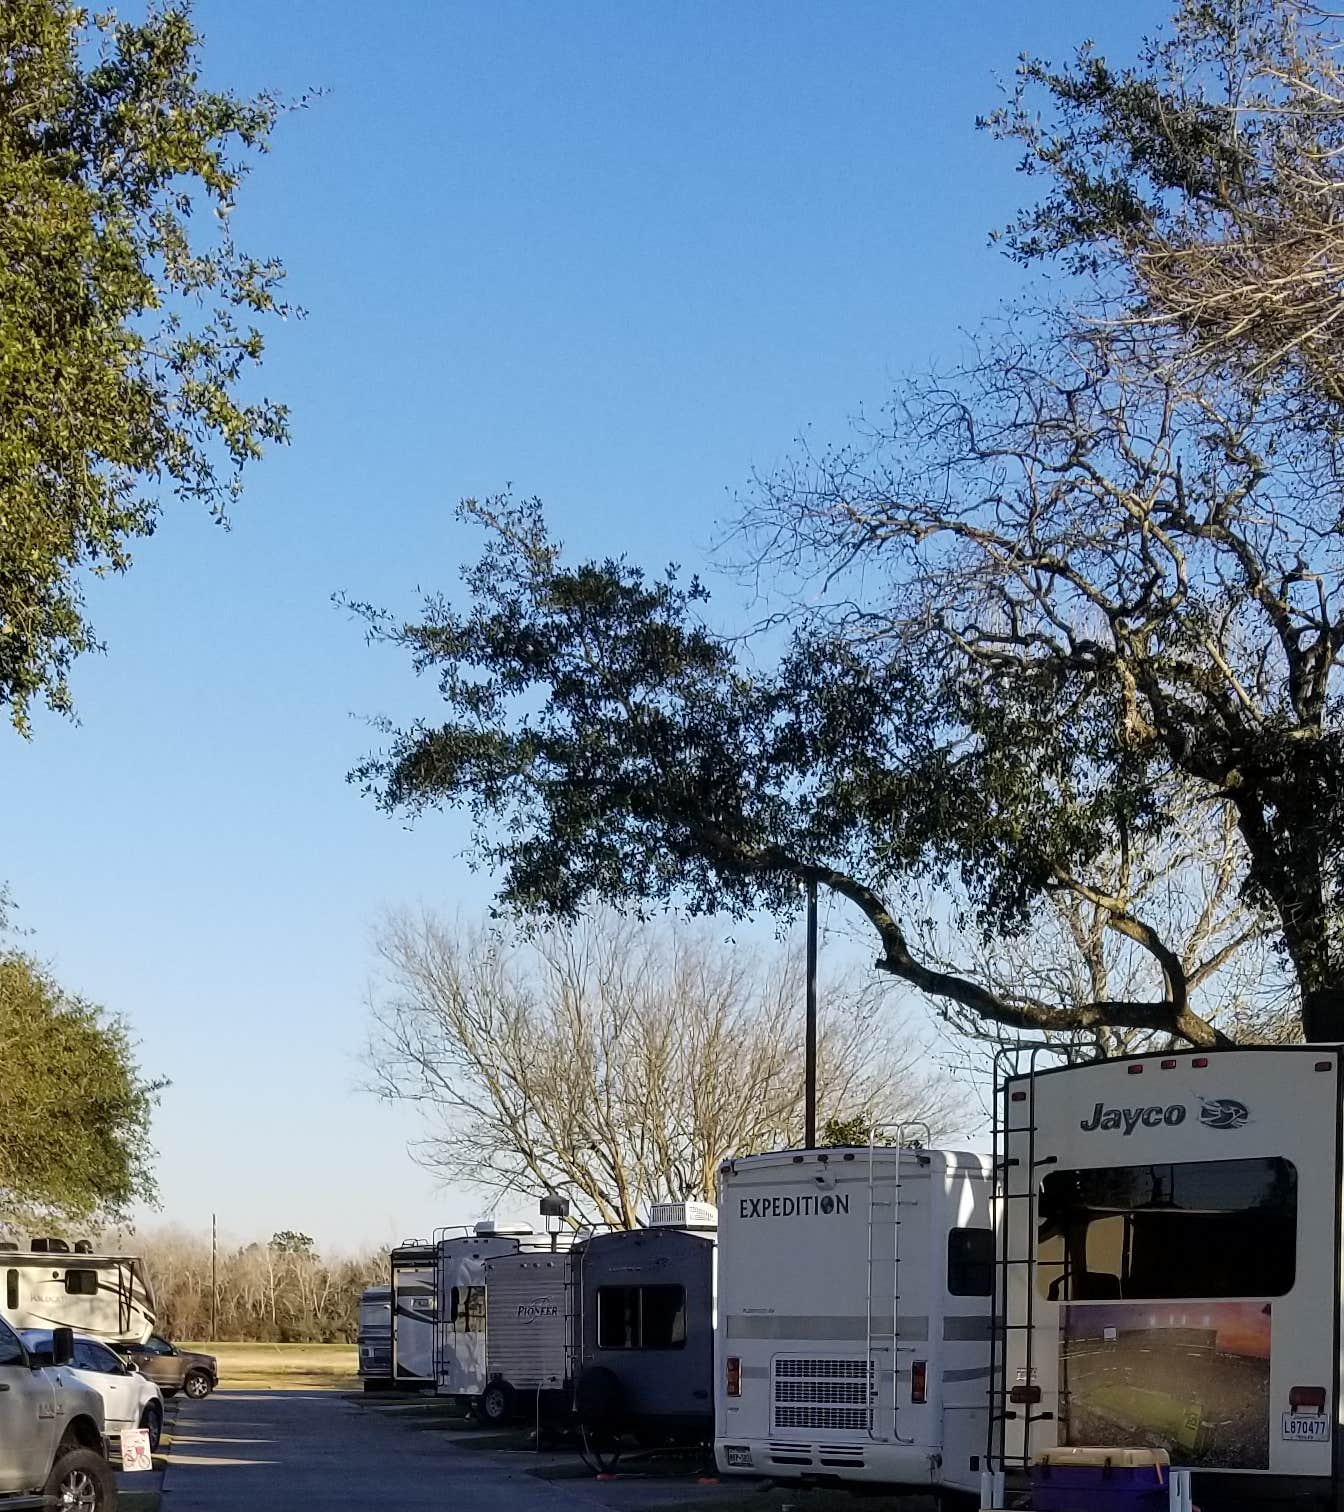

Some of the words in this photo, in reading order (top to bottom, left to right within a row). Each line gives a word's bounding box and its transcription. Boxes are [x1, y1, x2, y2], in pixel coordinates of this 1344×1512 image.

[1080, 1102, 1187, 1136] Jayco
[739, 1194, 849, 1219] EXPEDITION
[518, 1305, 558, 1317] PIONEER
[1284, 1420, 1326, 1435] L870477
